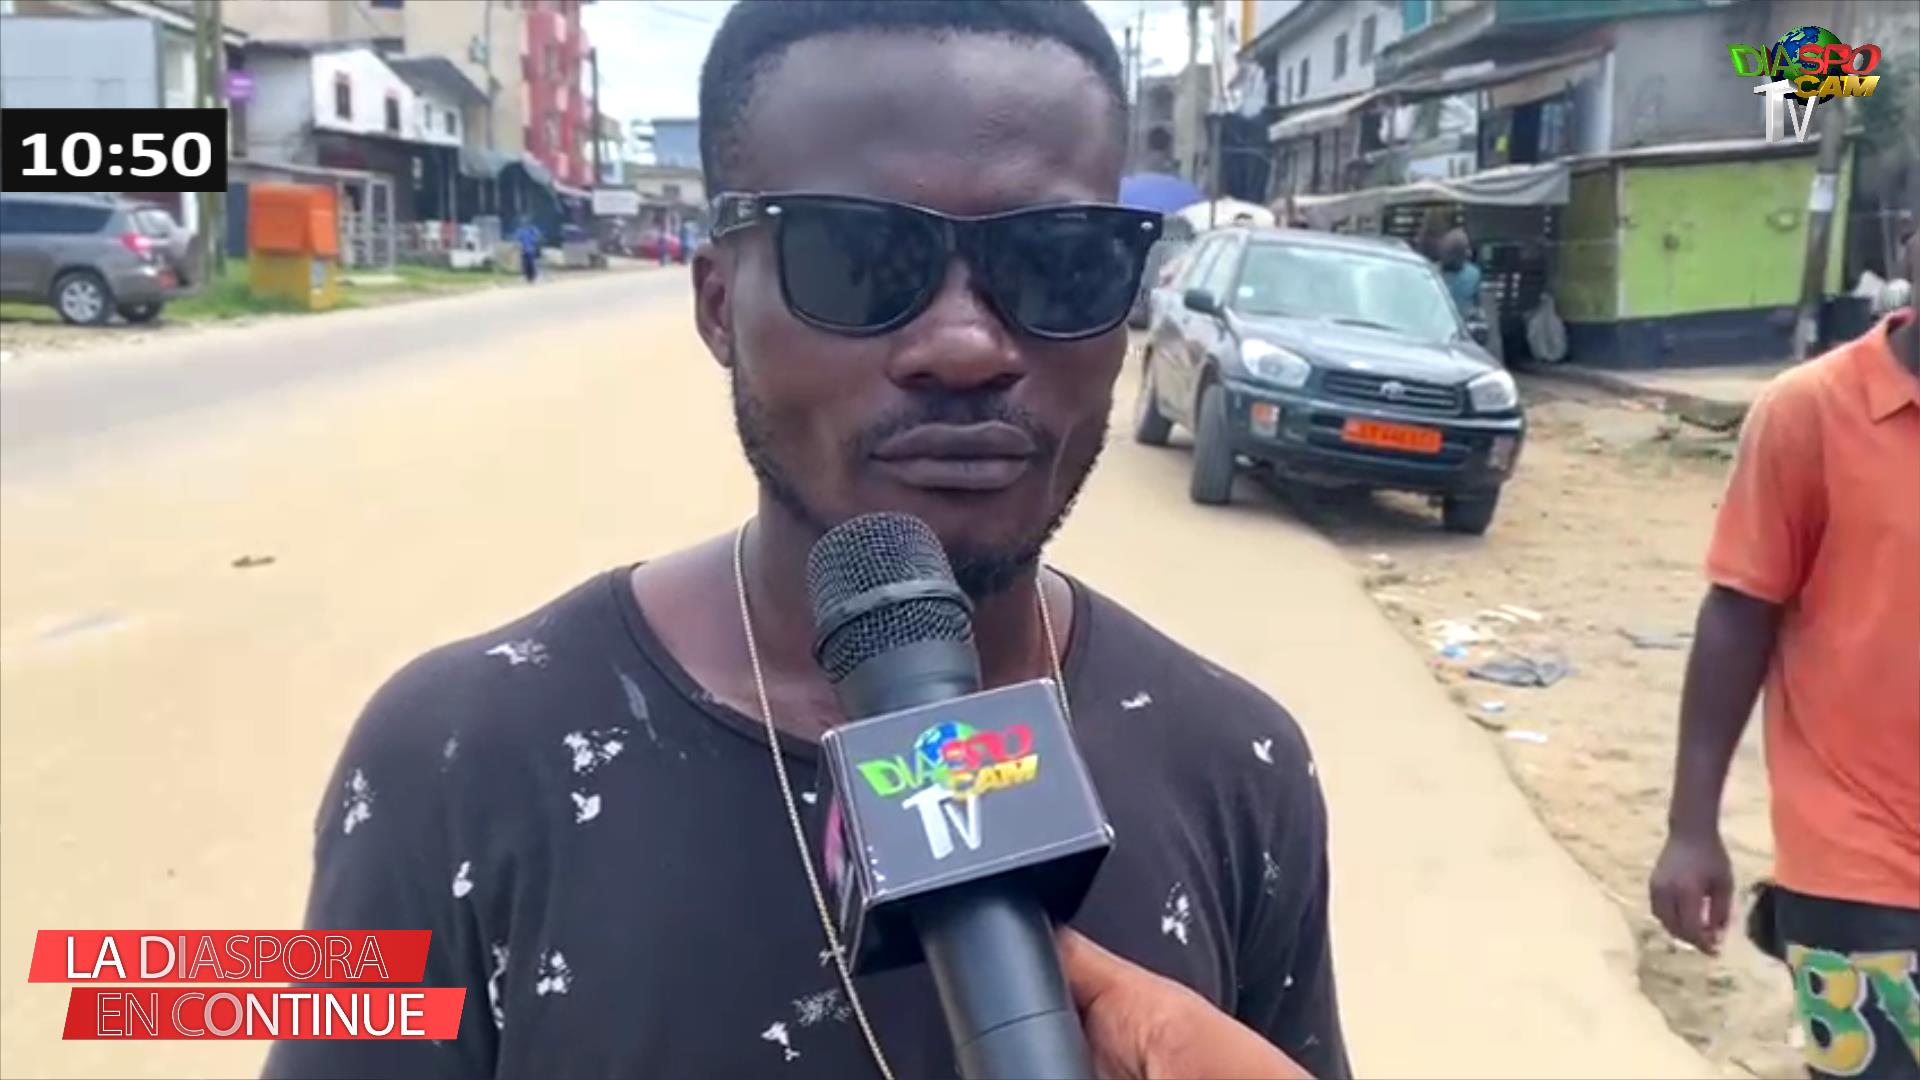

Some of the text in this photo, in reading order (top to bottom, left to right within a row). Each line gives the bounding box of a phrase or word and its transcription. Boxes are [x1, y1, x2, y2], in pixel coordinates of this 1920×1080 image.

[857, 723, 1034, 797] DIASPO
[950, 754, 1039, 801] CAM
[902, 783, 981, 860] TV
